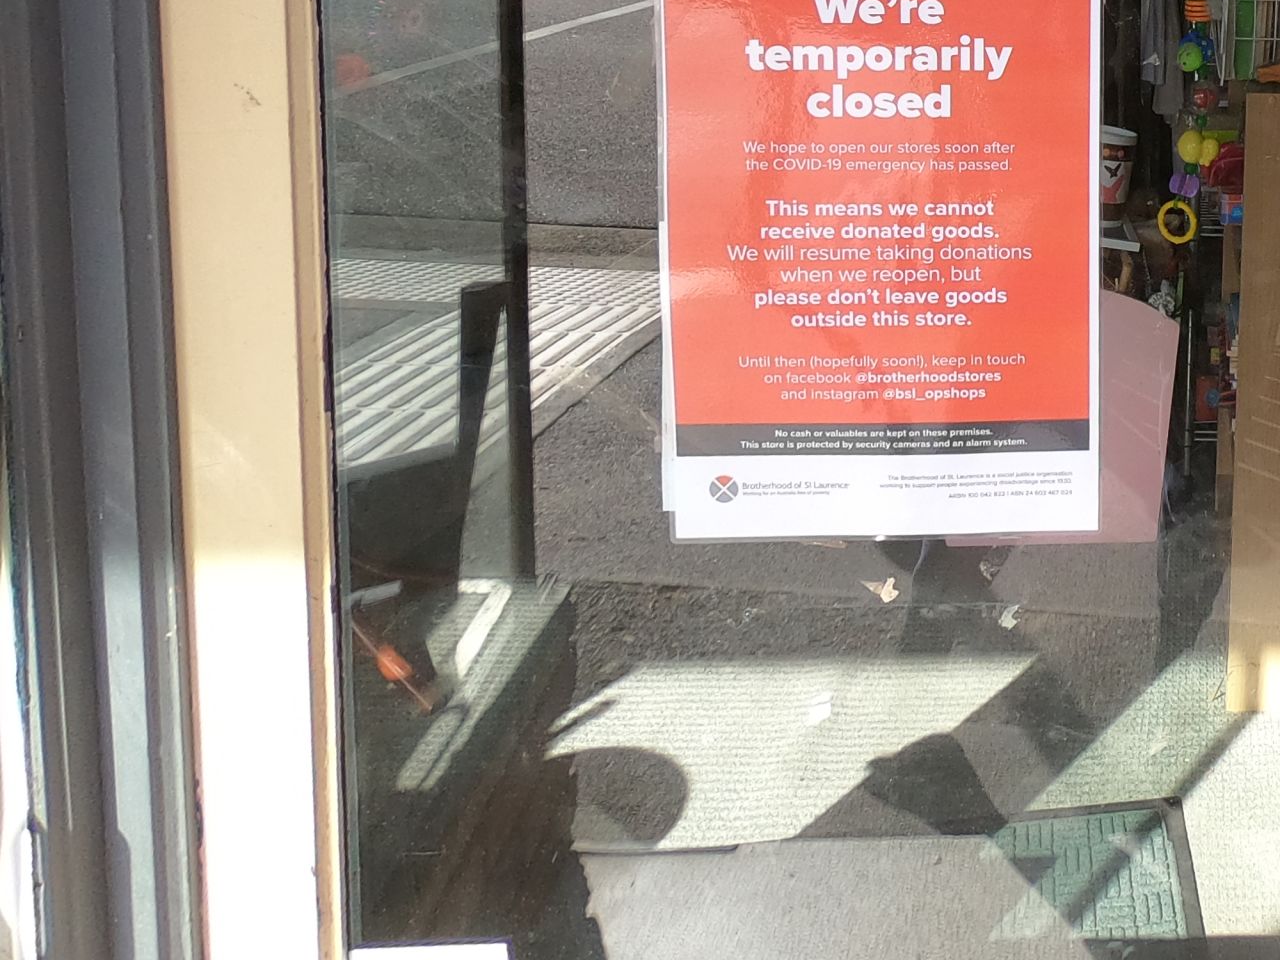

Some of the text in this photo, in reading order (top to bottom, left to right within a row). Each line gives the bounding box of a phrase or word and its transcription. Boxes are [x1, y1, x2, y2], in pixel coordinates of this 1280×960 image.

[745, 35, 1012, 81] temporarily
[807, 84, 951, 118] closed
[743, 141, 1015, 157] We hope to open our stores soon after
[745, 158, 1012, 174] the COVID-19 emergency has passed.
[766, 199, 994, 216] This means we cannot
[760, 222, 1000, 242] receive donated goods.
[727, 243, 1033, 265] We will resume taking donations
[781, 265, 981, 285] when we reopen, but
[754, 287, 1008, 309] please don’t leave goods
[791, 310, 972, 327] outside this store.
[738, 356, 771, 367] Until
[775, 356, 806, 367] then
[810, 355, 878, 369] (hopefully
[932, 354, 966, 369] keep
[970, 355, 983, 365] in
[986, 354, 1026, 365] touch
[763, 370, 1001, 384] on facebook @brotherhoodstores
[781, 388, 807, 400] and
[811, 388, 879, 402] instagram
[775, 429, 788, 438] No
[790, 428, 811, 437] cash
[813, 430, 823, 438] or
[825, 428, 868, 437] valuables
[887, 428, 906, 439] kept
[909, 429, 921, 437] on
[923, 428, 948, 437] these
[950, 428, 993, 438] premises.
[740, 440, 760, 449] This
[762, 441, 784, 449] store
[786, 441, 794, 449] is
[796, 440, 840, 450] protected
[842, 440, 853, 450] by
[855, 440, 890, 450] security
[893, 441, 930, 449] cameras
[933, 440, 949, 448] and
[966, 439, 991, 447] alarm
[993, 439, 1028, 448] system.
[742, 481, 792, 490] Brotherhood
[794, 481, 802, 490] of
[813, 481, 849, 490] Laurence
